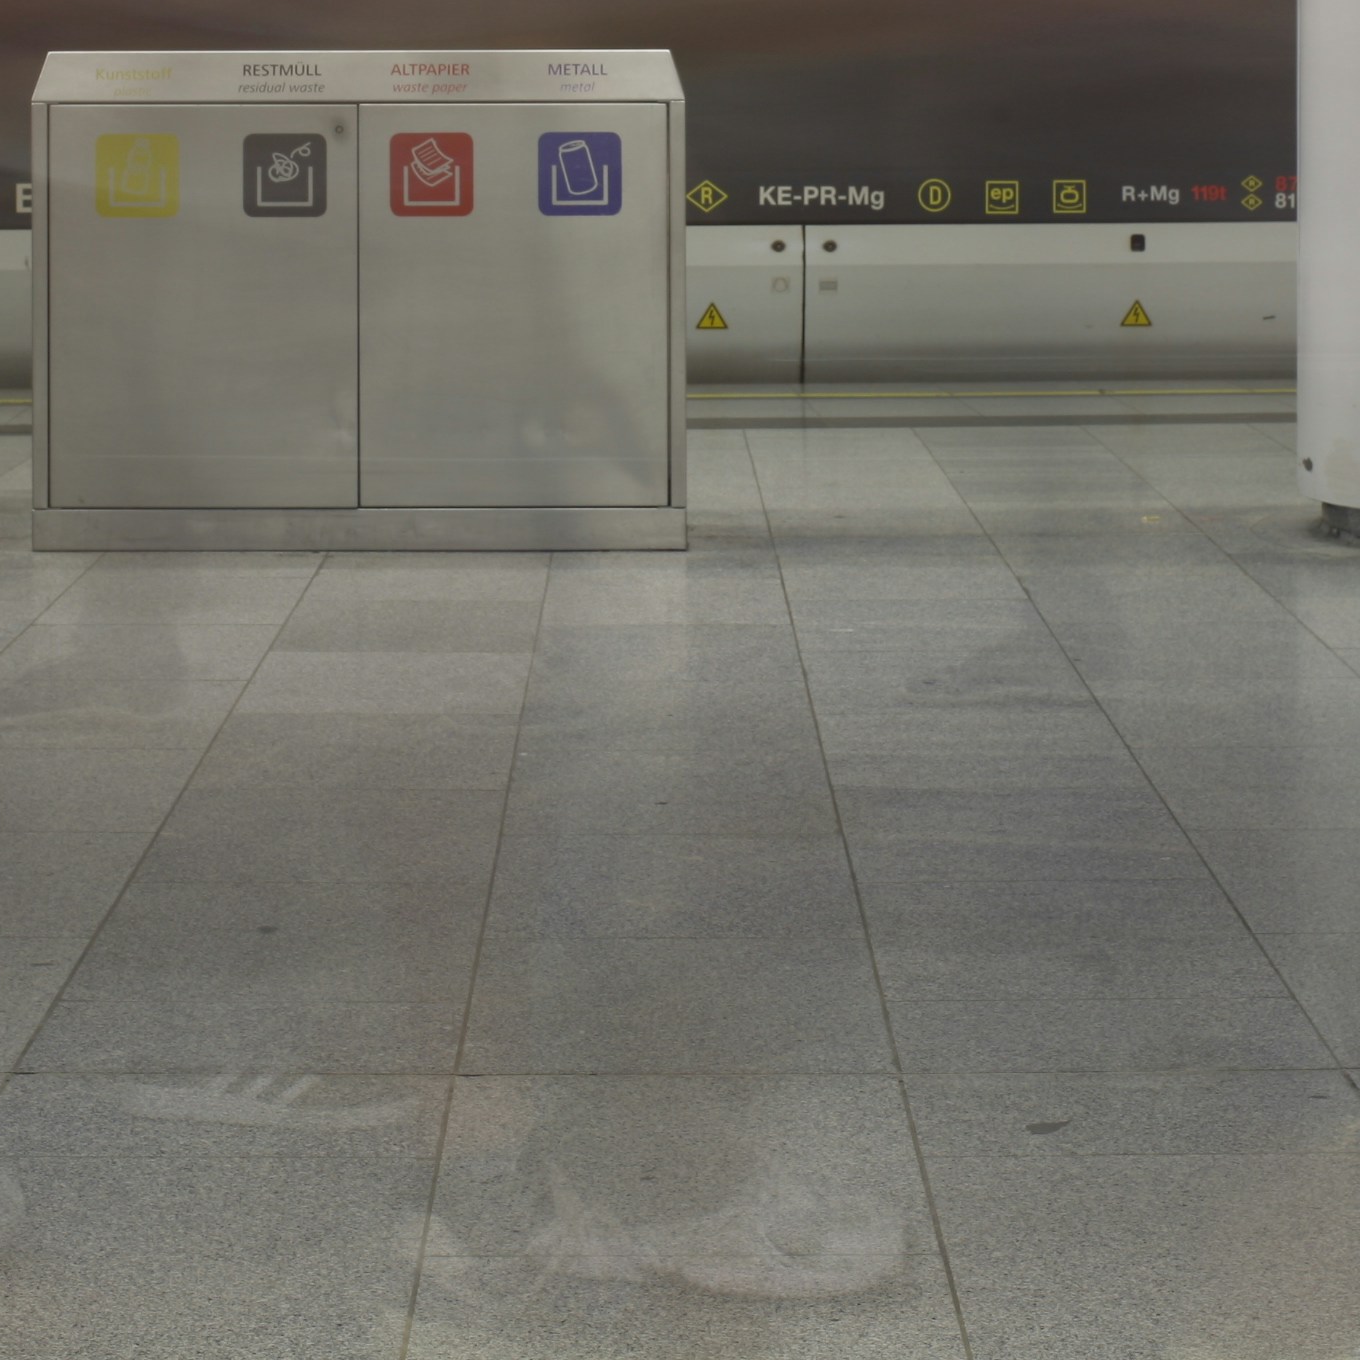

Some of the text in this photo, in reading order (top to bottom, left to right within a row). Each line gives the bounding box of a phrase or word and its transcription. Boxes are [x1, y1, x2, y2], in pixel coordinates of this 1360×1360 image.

[95, 68, 173, 81] Kunststoff
[242, 61, 322, 77] RESTMÜLL
[391, 63, 470, 76] ALTPAPIER
[548, 63, 608, 76] METALL
[238, 81, 325, 93] residual waste
[392, 82, 468, 96] waste paper
[560, 81, 595, 93] metal
[758, 186, 885, 210] KE-PR-Mg
[930, 186, 942, 205] D
[990, 187, 1014, 204] ep
[1121, 185, 1180, 205] R+Mg
[1190, 184, 1228, 201] 119t
[1275, 192, 1295, 208] 81
